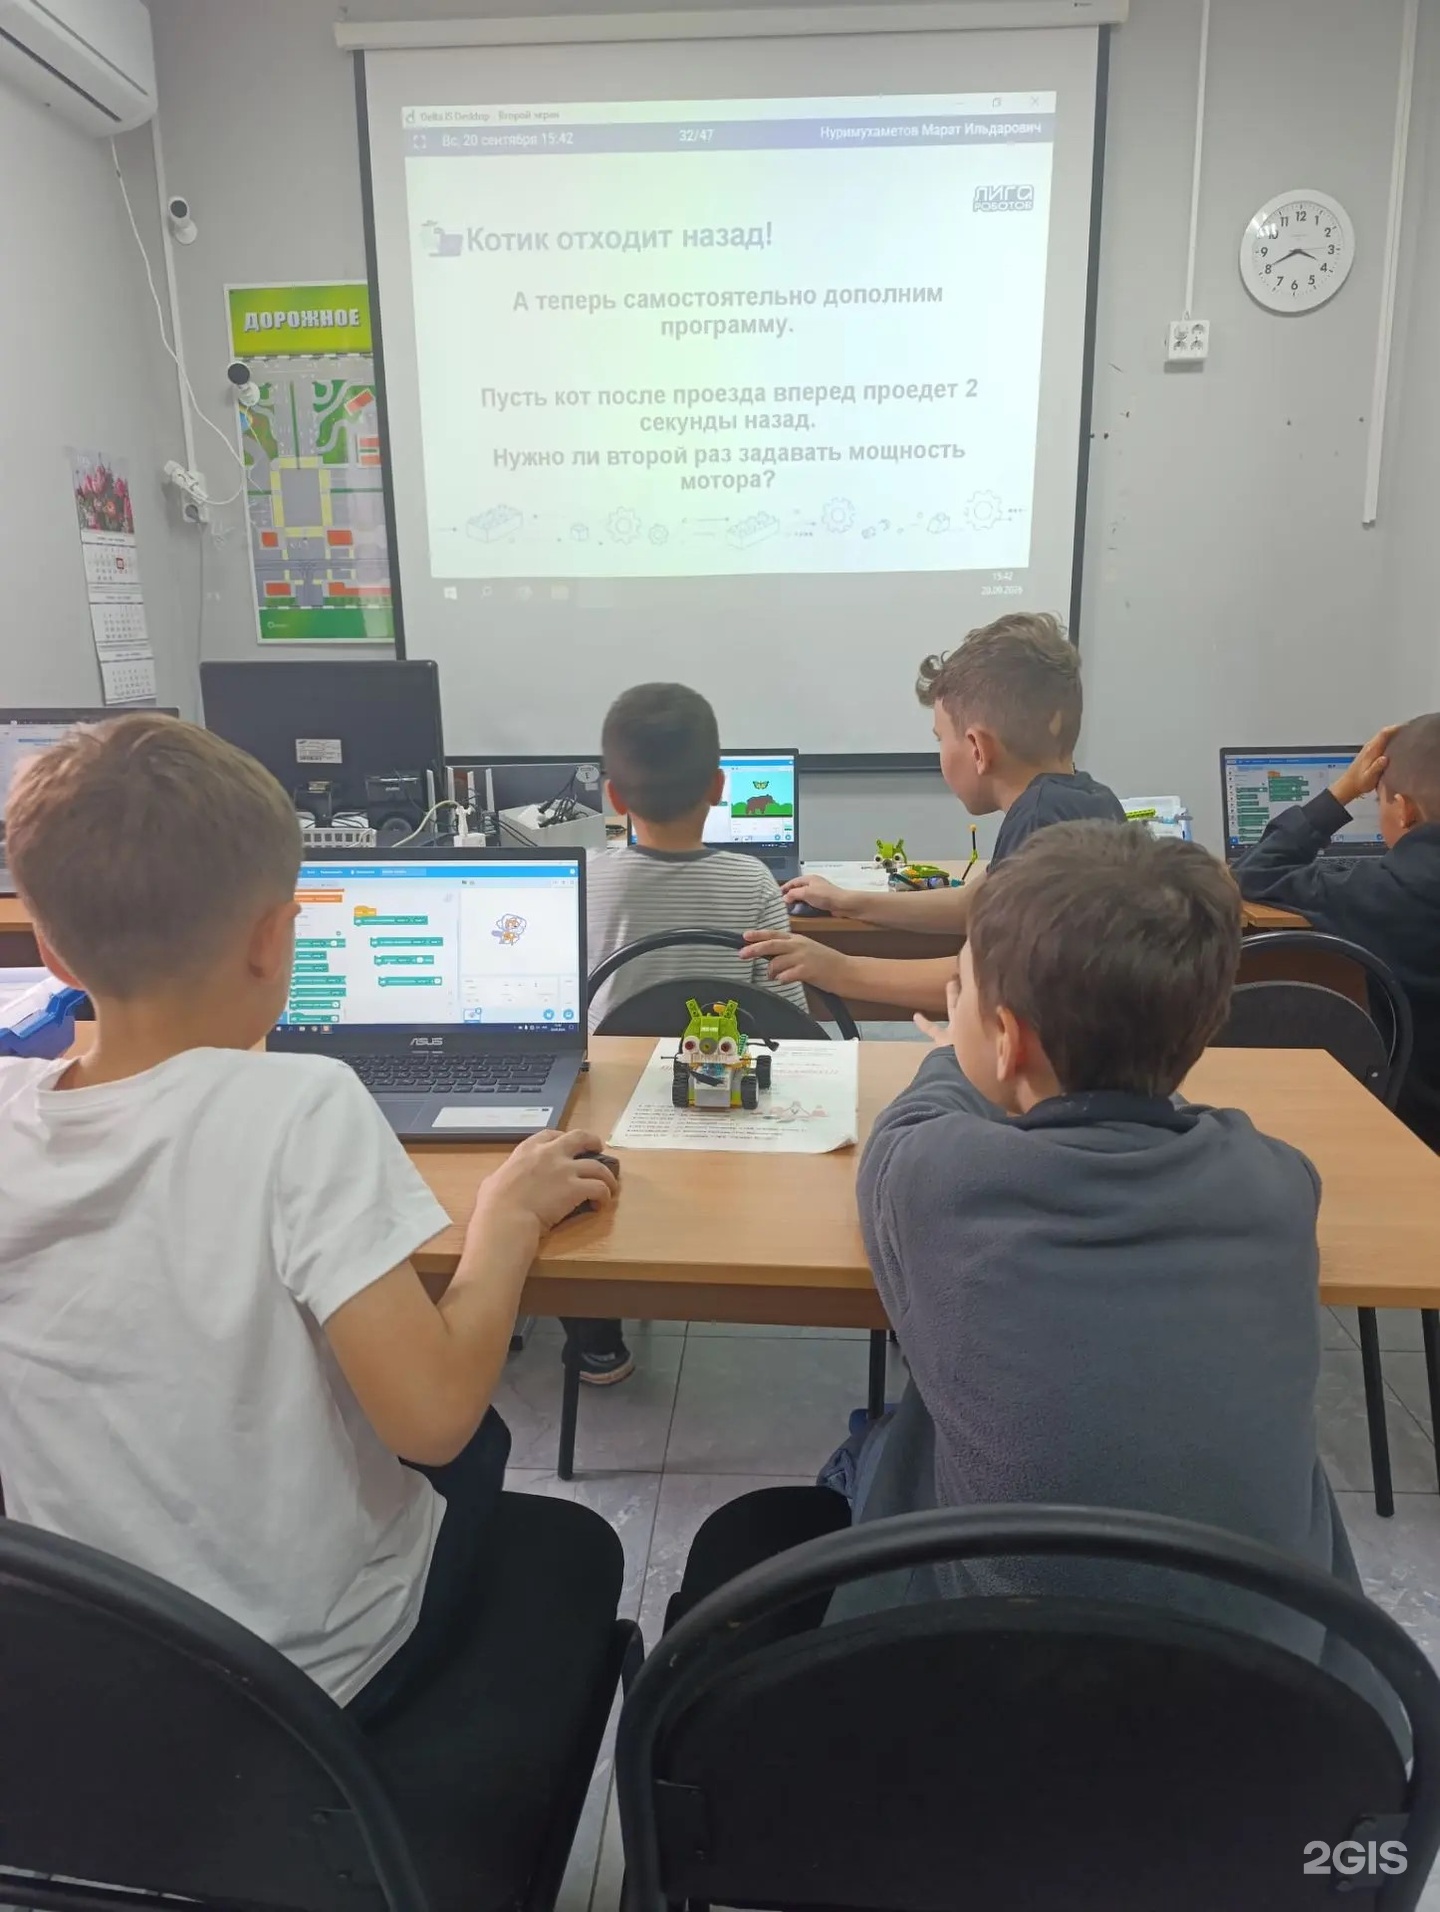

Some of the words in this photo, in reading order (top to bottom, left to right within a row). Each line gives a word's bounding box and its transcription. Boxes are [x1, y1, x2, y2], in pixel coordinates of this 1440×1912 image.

[679, 128, 714, 143] 32/47
[921, 123, 961, 137] Марат
[964, 121, 1042, 137] Ильдарович
[463, 134, 478, 147] 20
[481, 133, 538, 148] сентября
[542, 132, 574, 145] 15:42
[1280, 216, 1289, 227] 11
[1295, 211, 1307, 222] 12
[467, 226, 550, 251] Котик
[556, 227, 673, 254] отходит
[682, 221, 773, 250] назад!
[1324, 227, 1331, 238] 2
[1261, 247, 1268, 257] 9
[1328, 244, 1335, 255] 3
[1264, 264, 1272, 275] 8
[1320, 263, 1328, 273] 4
[1277, 276, 1284, 287] 7
[1291, 280, 1298, 291] 6
[1308, 275, 1315, 285] 5
[512, 291, 529, 311] А
[536, 290, 616, 314] теперь
[623, 288, 817, 311] самостоятельно
[823, 286, 944, 308] дополним
[244, 308, 361, 333] ДОРОЖНОЕ
[661, 317, 795, 340] программу.
[481, 387, 548, 413] Пусть
[554, 389, 592, 406] кот
[598, 388, 666, 406] после
[673, 385, 767, 409] проезда
[773, 383, 856, 406] вперед
[863, 381, 958, 405] проедет
[965, 378, 979, 398] 2
[639, 413, 737, 436] секунды
[744, 411, 816, 432] назад.
[492, 448, 565, 472] Нужно
[571, 449, 600, 466] ли
[606, 446, 688, 470] второй
[694, 447, 732, 470] раз
[739, 445, 842, 466] задавать
[848, 442, 966, 465] мощность
[680, 469, 776, 494] мотора?
[410, 1037, 443, 1046] ASUS
